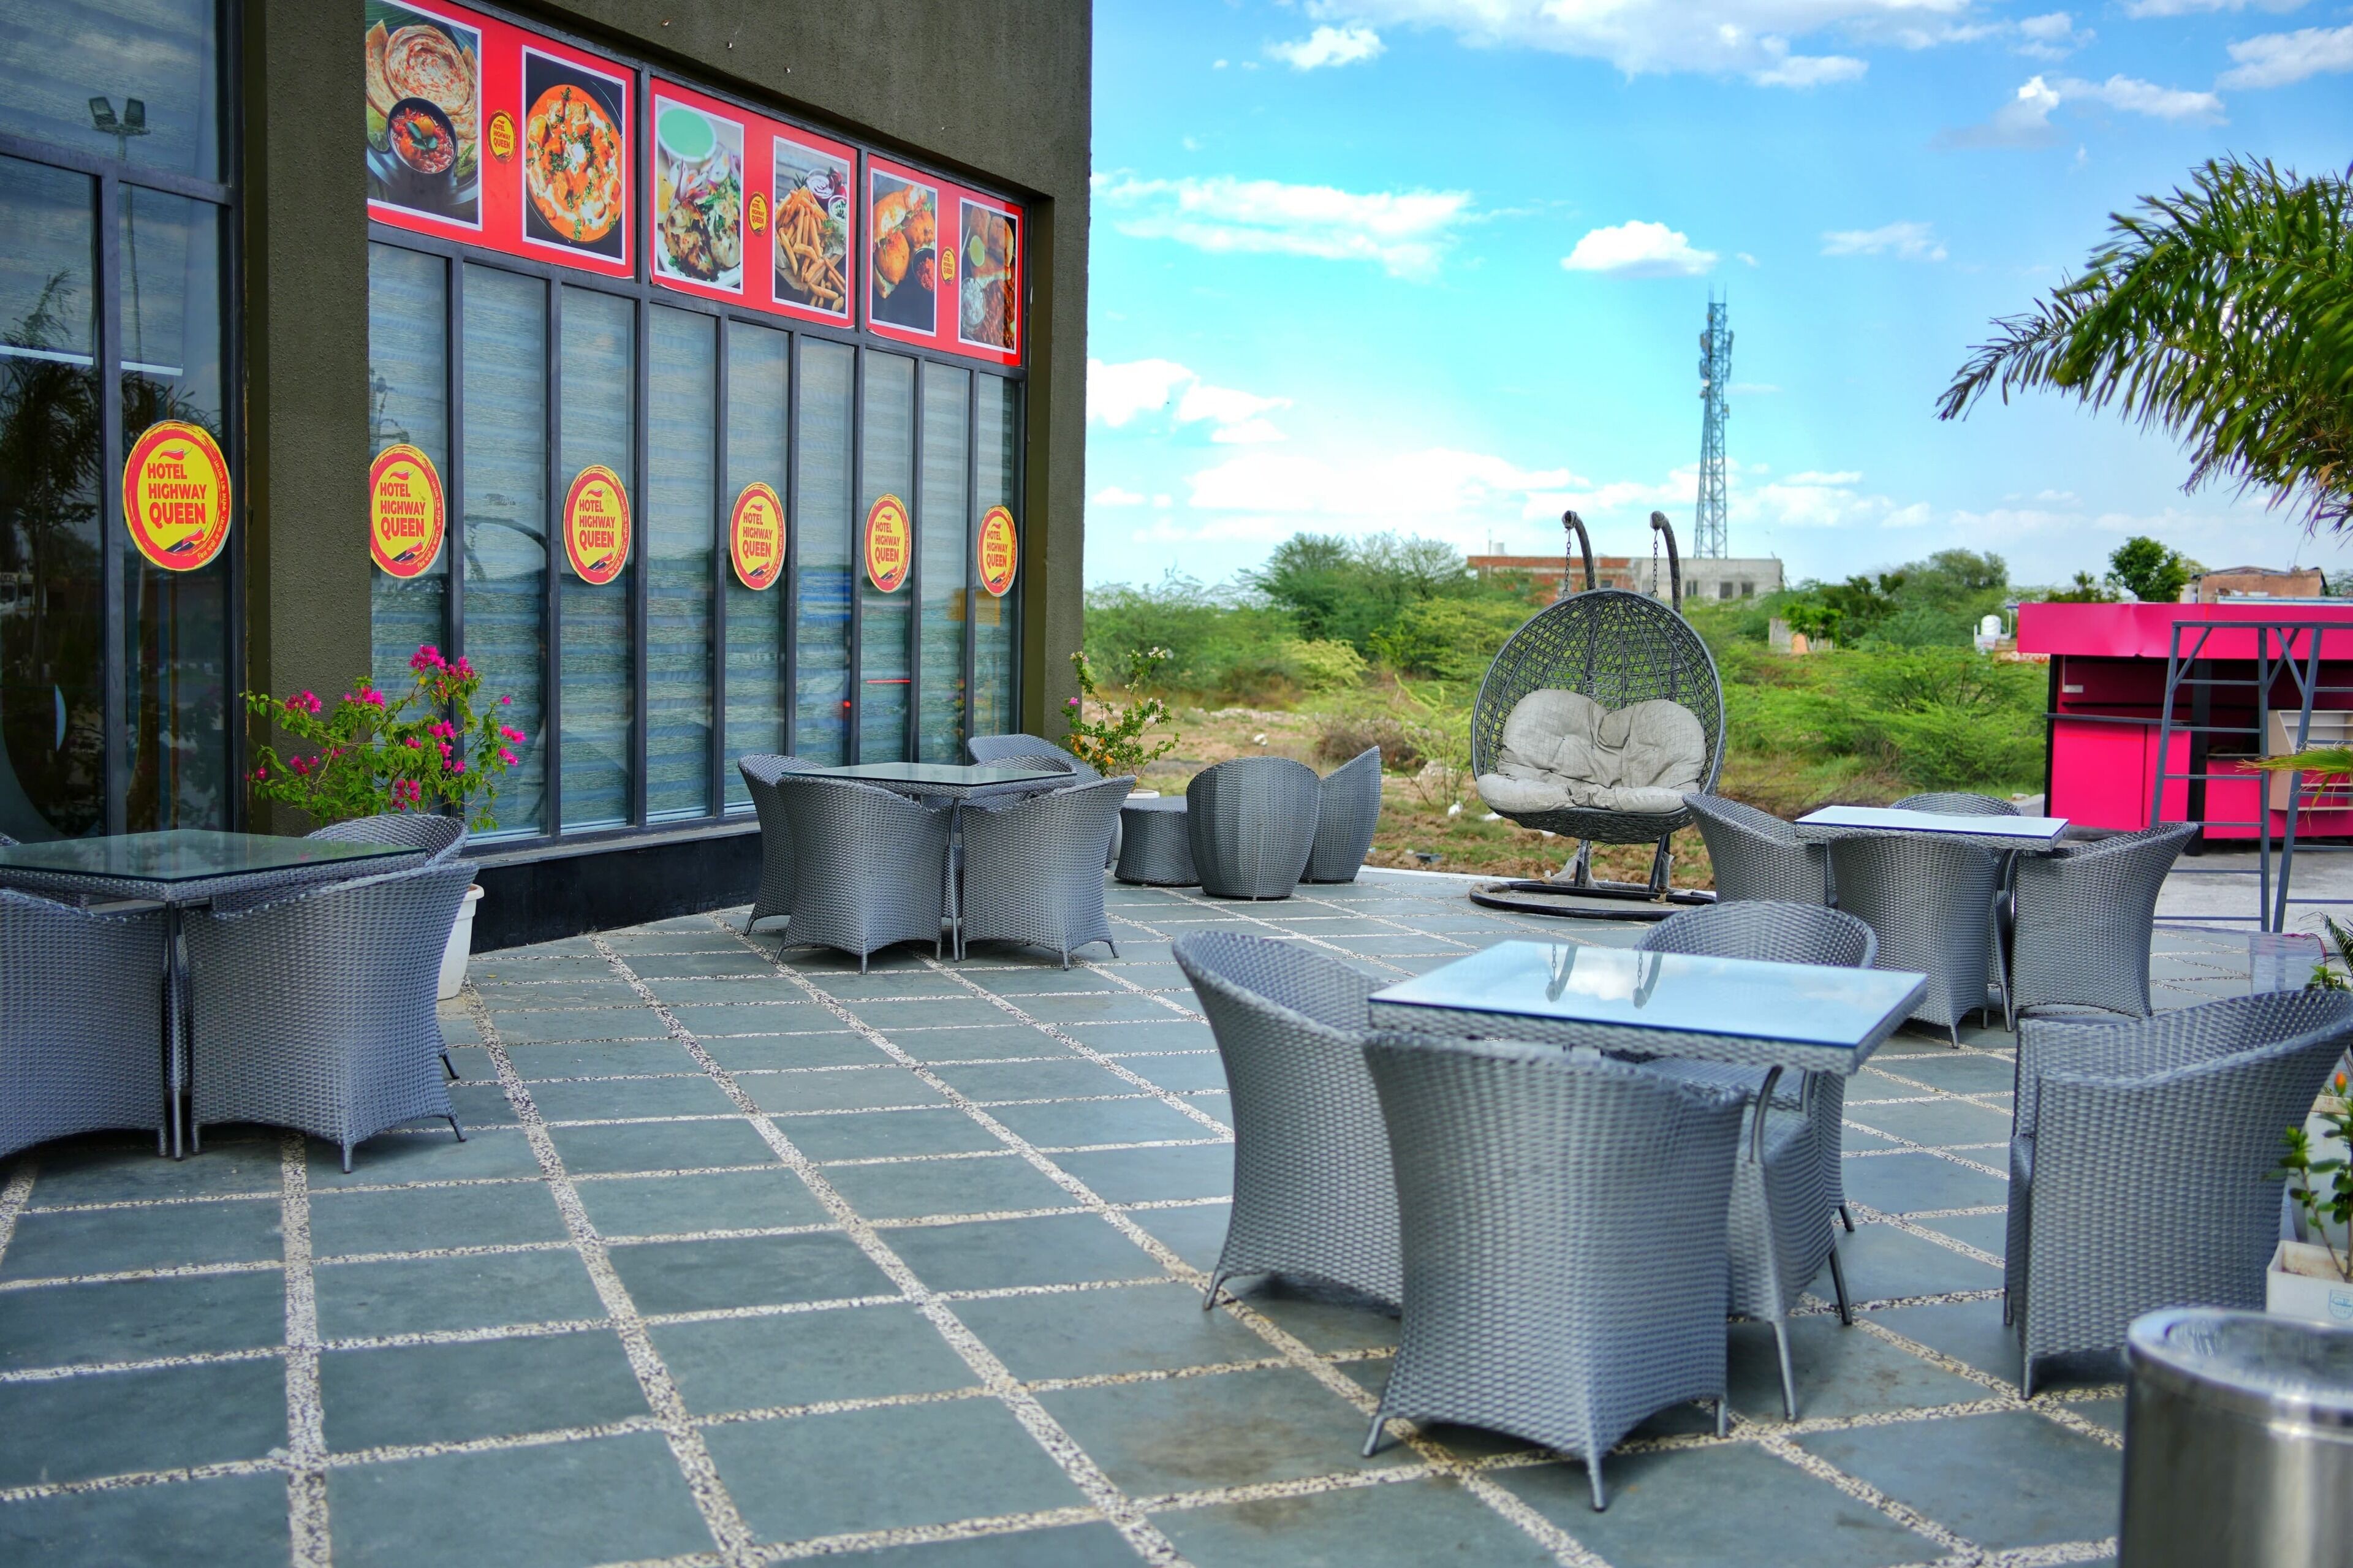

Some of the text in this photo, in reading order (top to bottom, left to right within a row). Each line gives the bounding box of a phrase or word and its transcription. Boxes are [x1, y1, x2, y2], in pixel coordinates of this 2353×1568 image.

[493, 137, 510, 149] QUEEN
[147, 463, 188, 480] HOTEL
[148, 483, 207, 500] HIGHWAY
[380, 482, 411, 498] HOTEL
[380, 499, 426, 515] HIGHWAY
[579, 499, 604, 513] HOTEL
[149, 502, 207, 529] QUEEN
[579, 515, 616, 529] HIGHWAY
[743, 512, 763, 525] HOTEL
[381, 516, 425, 540] QUEEN
[743, 526, 773, 540] HIGHWAY
[875, 521, 892, 533] HOTEL
[987, 530, 1001, 540] HOTEL
[579, 529, 615, 551] QUEEN
[875, 534, 900, 547] HIGHWAY
[987, 542, 1008, 553] HIGHWAY
[742, 541, 771, 559] QUEEN
[875, 547, 899, 564] QUEEN
[987, 553, 1007, 569] QUEEN
